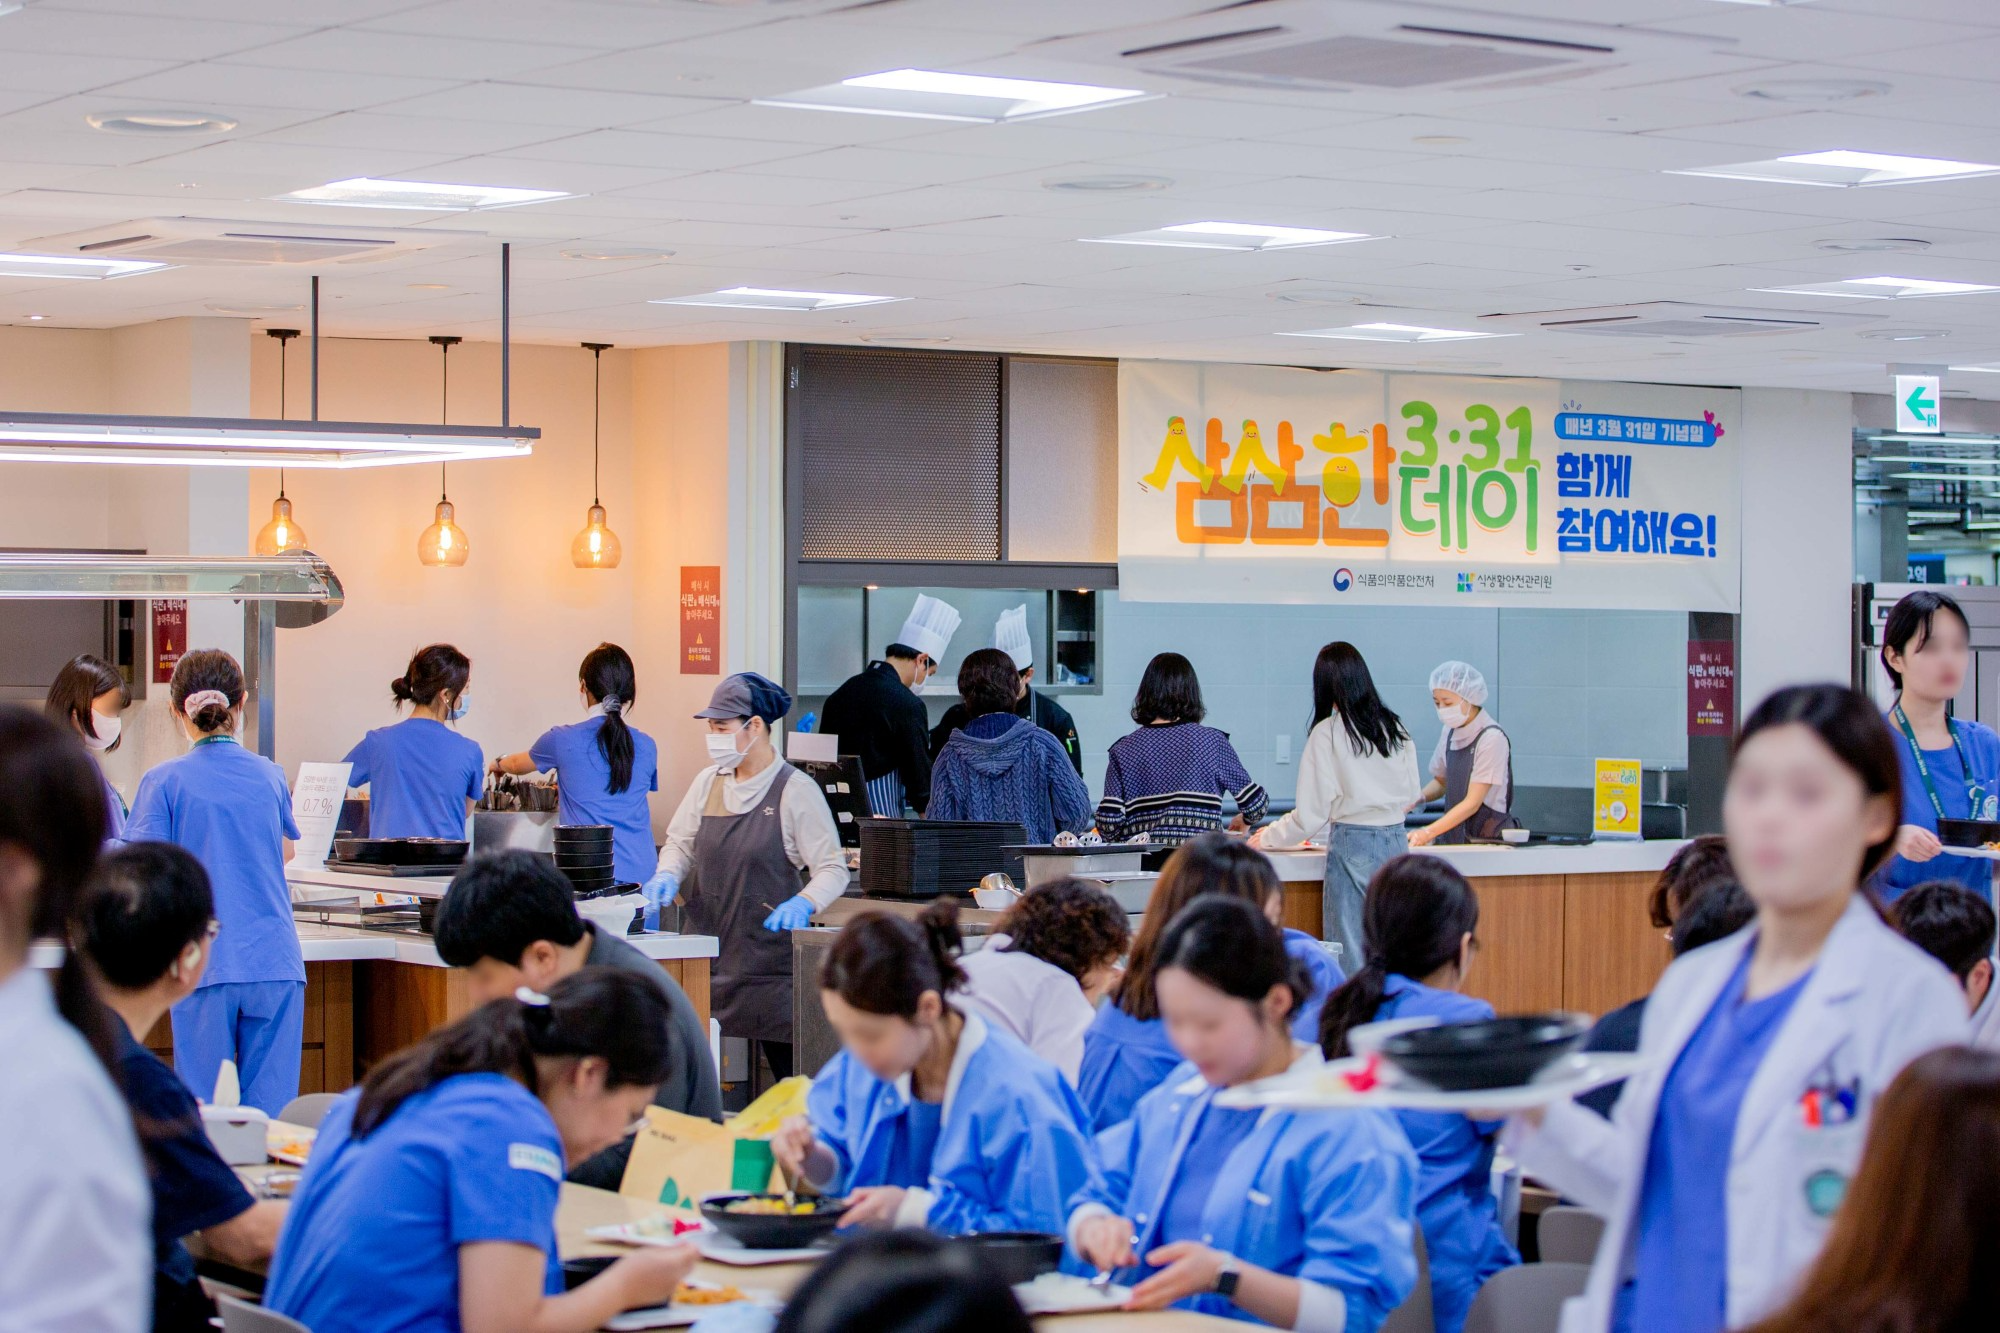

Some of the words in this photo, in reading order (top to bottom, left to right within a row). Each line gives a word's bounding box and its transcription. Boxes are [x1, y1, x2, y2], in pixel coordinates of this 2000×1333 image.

[1565, 417, 1593, 436] 매년
[1597, 419, 1622, 437] 3월
[1626, 421, 1656, 441] 31일
[1661, 423, 1704, 443] 기념일
[1142, 415, 1396, 547] 삼삼한
[1556, 452, 1632, 498] 함께
[1399, 464, 1538, 555] 데이
[1556, 507, 1717, 558] 참여해요!
[691, 580, 702, 591] 배식
[703, 580, 710, 591] 시
[1357, 573, 1434, 588] 식품의약품안전처
[1477, 573, 1553, 589] 식생활안전관리원
[1699, 653, 1712, 663] 배식
[1714, 653, 1721, 663] 시
